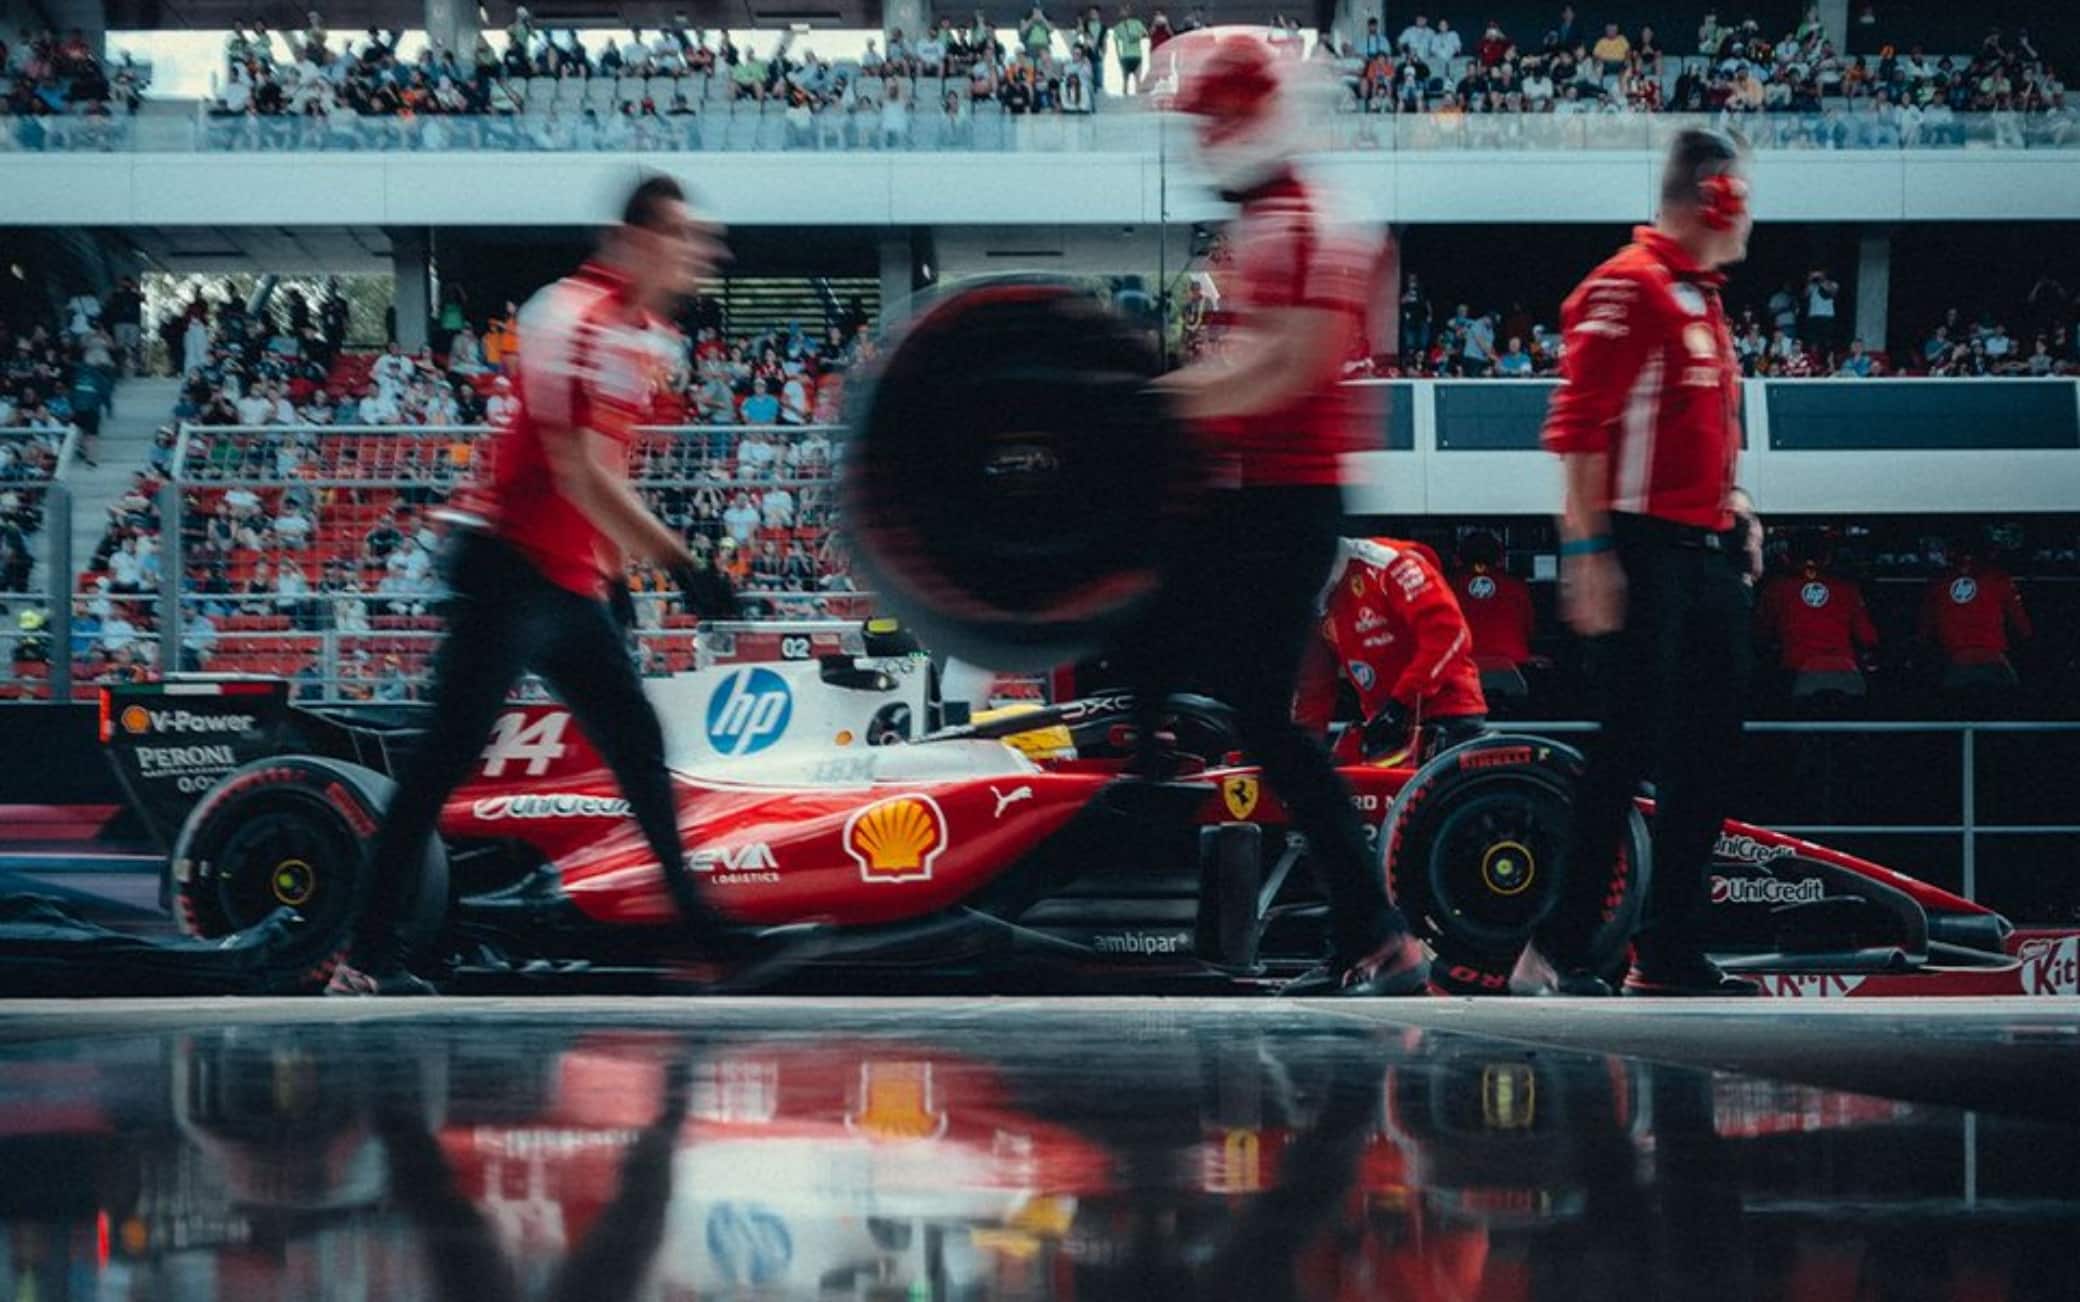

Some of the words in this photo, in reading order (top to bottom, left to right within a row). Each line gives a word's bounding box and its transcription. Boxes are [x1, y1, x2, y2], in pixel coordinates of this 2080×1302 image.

[150, 709, 256, 733] V-Power
[711, 667, 788, 755] hp
[135, 744, 236, 768] PERONI
[683, 843, 778, 871] EVA
[1729, 878, 1822, 901] UniCredit
